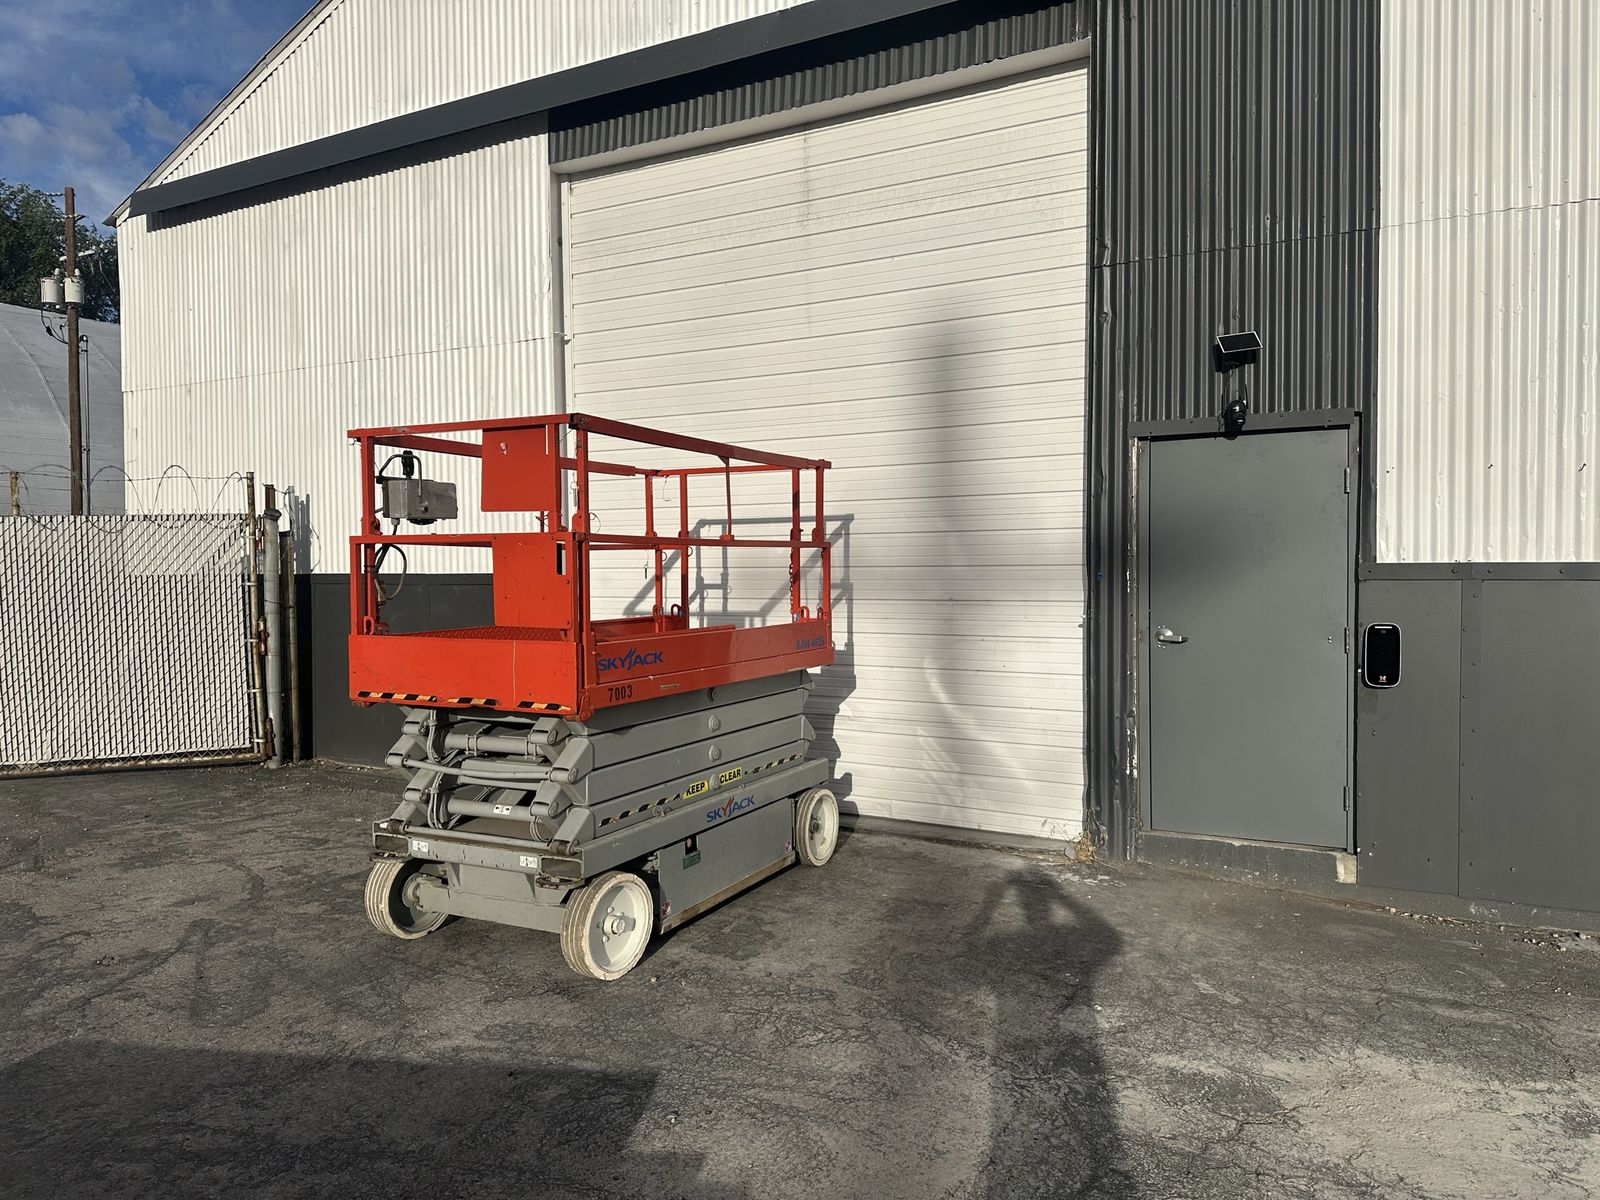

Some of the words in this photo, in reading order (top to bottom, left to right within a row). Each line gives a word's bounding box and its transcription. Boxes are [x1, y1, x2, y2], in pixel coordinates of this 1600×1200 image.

[598, 648, 664, 671] SKYJACK
[608, 685, 633, 702] 7003
[686, 782, 706, 796] KEEP
[720, 768, 741, 784] CLEAR
[706, 795, 755, 822] SKYJACK
